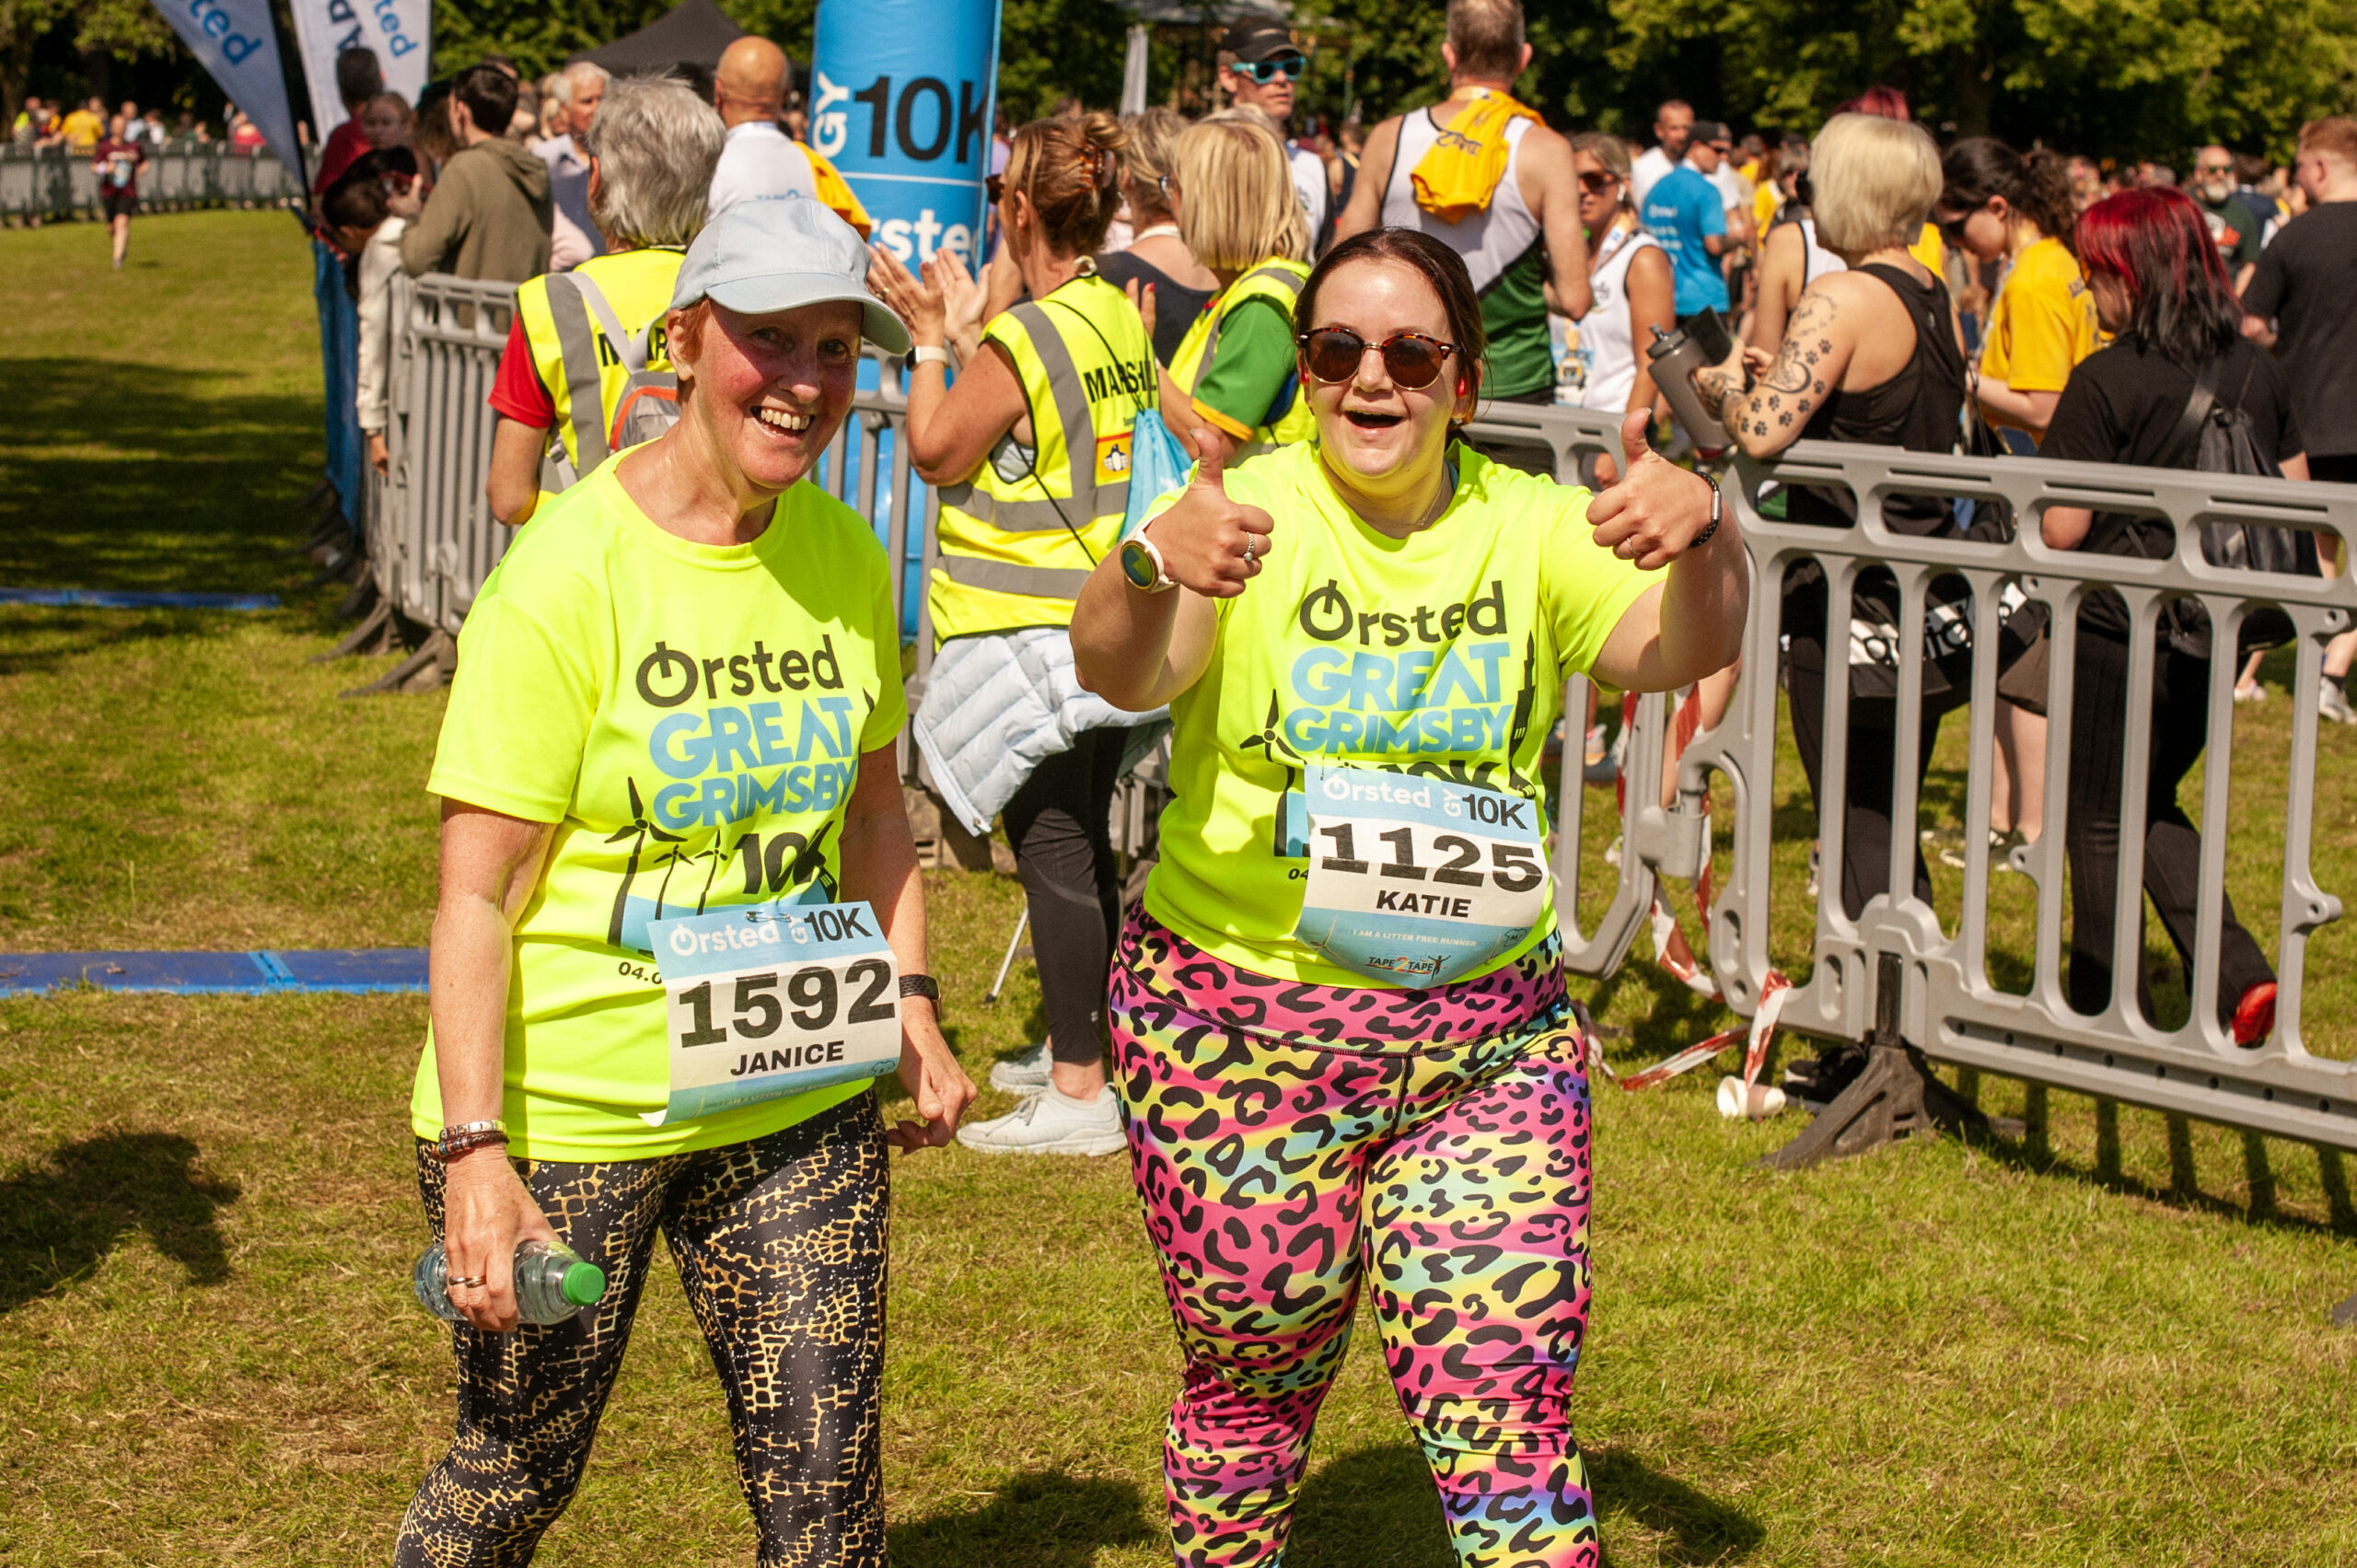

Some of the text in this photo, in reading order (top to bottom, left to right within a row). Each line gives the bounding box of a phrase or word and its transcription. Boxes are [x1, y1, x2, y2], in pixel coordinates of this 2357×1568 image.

[1291, 642, 1510, 712] GREAT
[649, 697, 853, 780] GREAT
[1283, 703, 1514, 754] GRIMSBY
[654, 760, 856, 830] GRIMSBY
[1462, 794, 1528, 830] 10K
[1320, 823, 1543, 893] 1125
[804, 907, 873, 942] 10K
[1376, 889, 1472, 918] KATIE
[1383, 932, 1414, 941] LITTER
[1416, 935, 1438, 944] FREE
[1440, 936, 1477, 947] RUNNER
[679, 958, 896, 1048] 1592
[730, 1040, 844, 1076] JANICE
